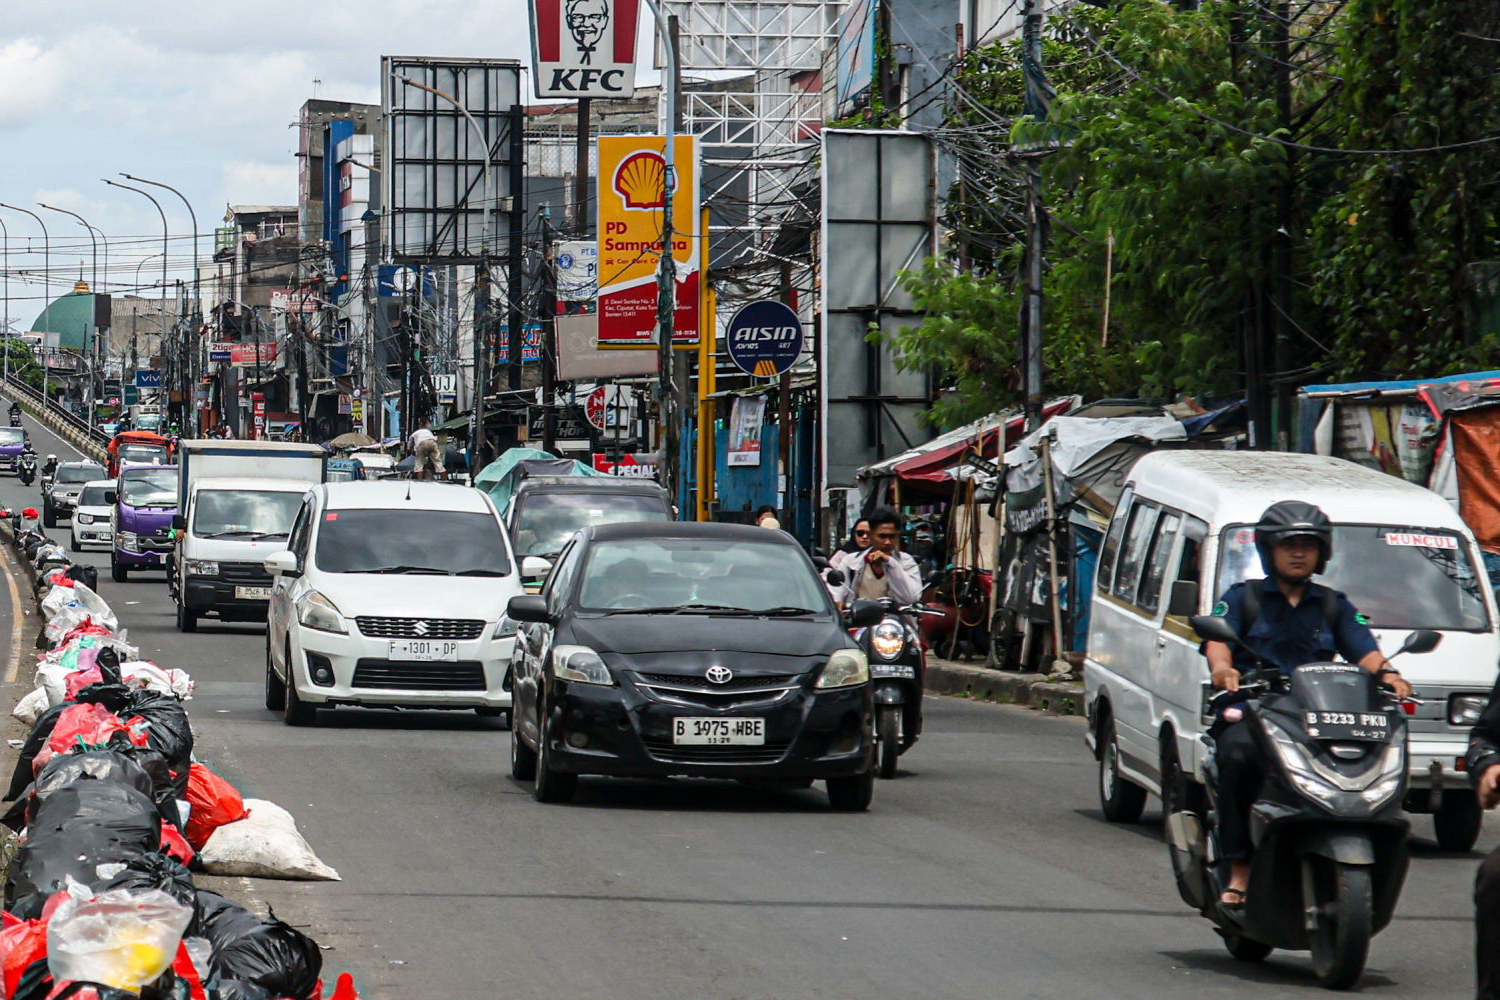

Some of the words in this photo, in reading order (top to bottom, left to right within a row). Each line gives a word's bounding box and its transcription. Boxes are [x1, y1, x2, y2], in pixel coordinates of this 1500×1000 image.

[548, 68, 624, 92] KFC
[606, 222, 627, 235] PD
[735, 326, 797, 341] AISIN
[1389, 533, 1457, 549] MUNCUL
[390, 642, 396, 653] F
[408, 642, 430, 654] 1301
[443, 642, 457, 655] DP
[1307, 712, 1317, 724] B
[1322, 713, 1356, 725] 3233
[1360, 714, 1387, 727] PKU
[676, 720, 685, 736] B
[693, 720, 729, 736] 1975
[735, 721, 762, 736] WBE
